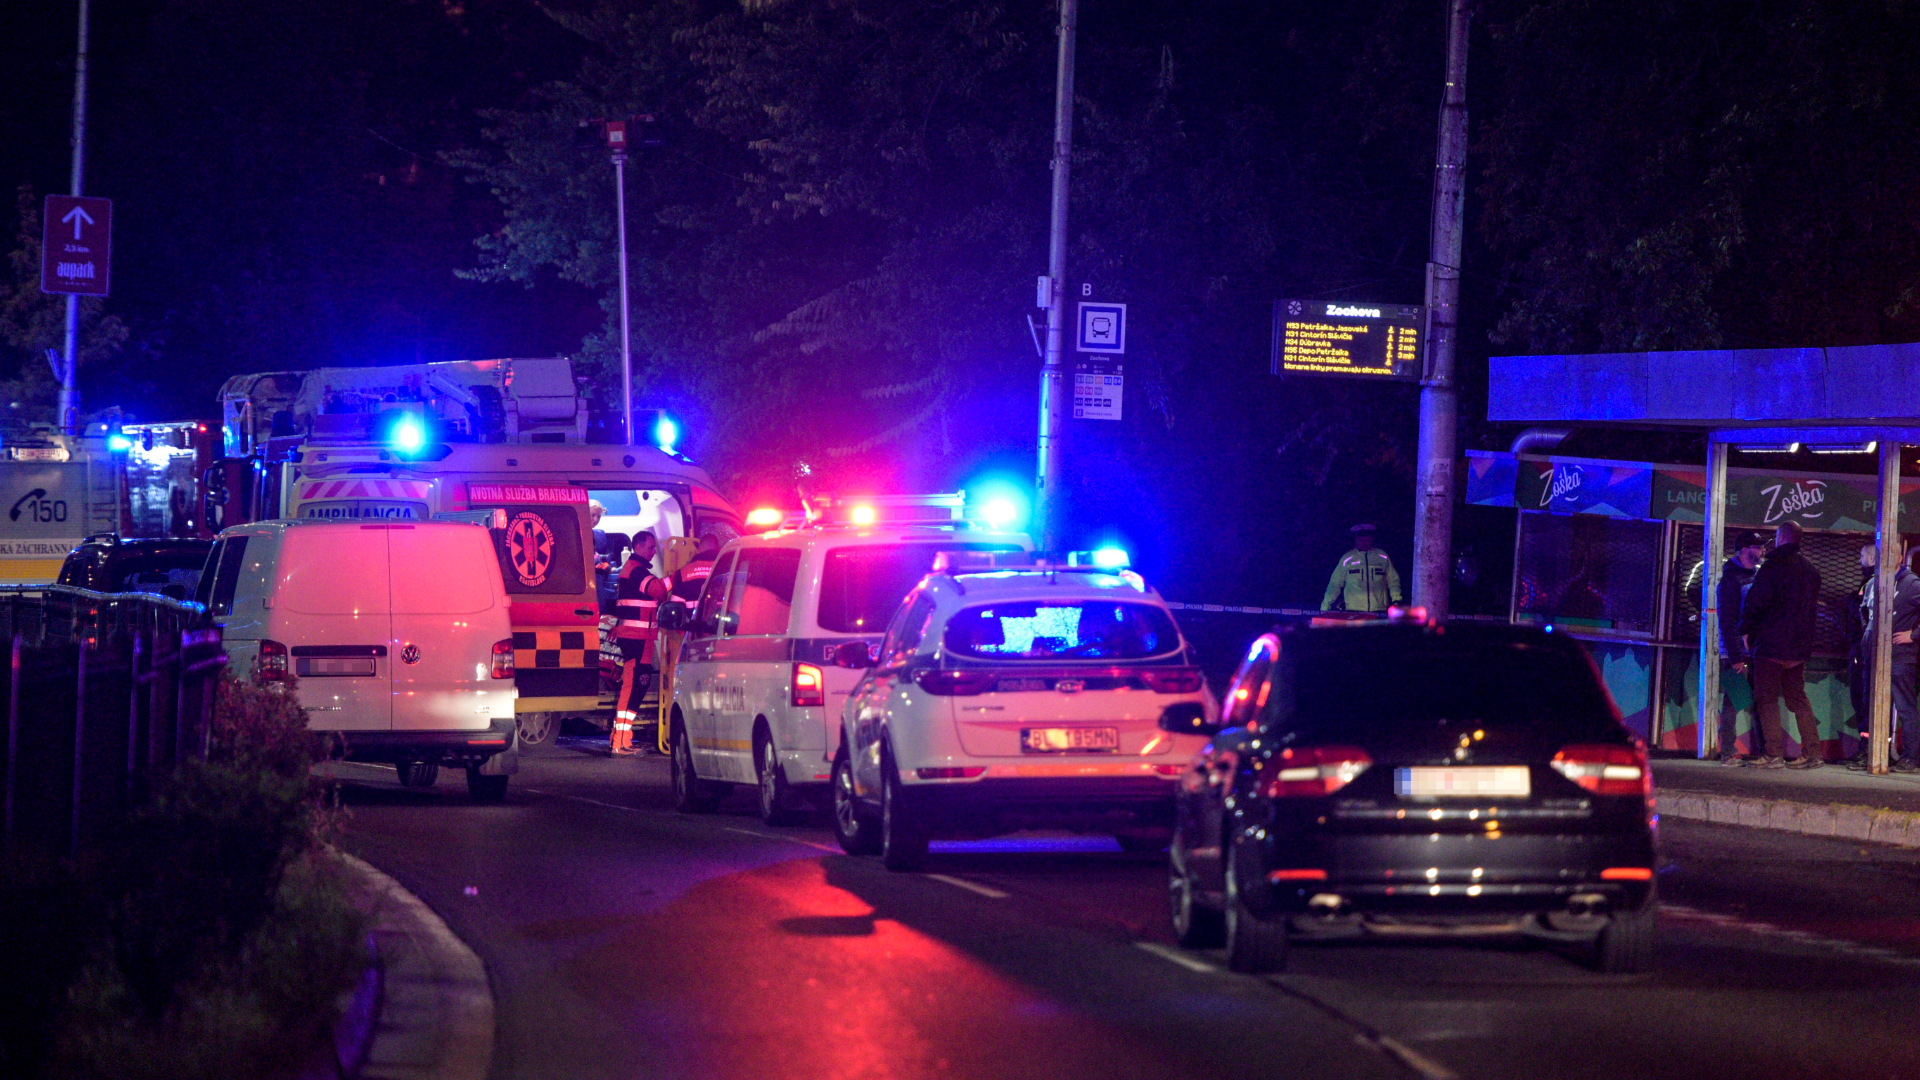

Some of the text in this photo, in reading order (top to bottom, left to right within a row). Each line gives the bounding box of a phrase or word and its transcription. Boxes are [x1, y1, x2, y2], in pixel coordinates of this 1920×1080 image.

[57, 261, 95, 280] aupark
[1082, 283, 1092, 296] B
[1326, 304, 1381, 318] Zochova
[1399, 327, 1405, 335] 2
[1403, 352, 1415, 360] min
[1540, 466, 1581, 507] Zoška
[505, 486, 537, 501] SLUŽBA
[538, 487, 587, 502] BRATISLAVA
[1761, 482, 1825, 524] Zoška
[1862, 500, 1906, 514] PIA
[28, 500, 67, 522] 150
[15, 541, 74, 554] ZÁCHRANNÁ
